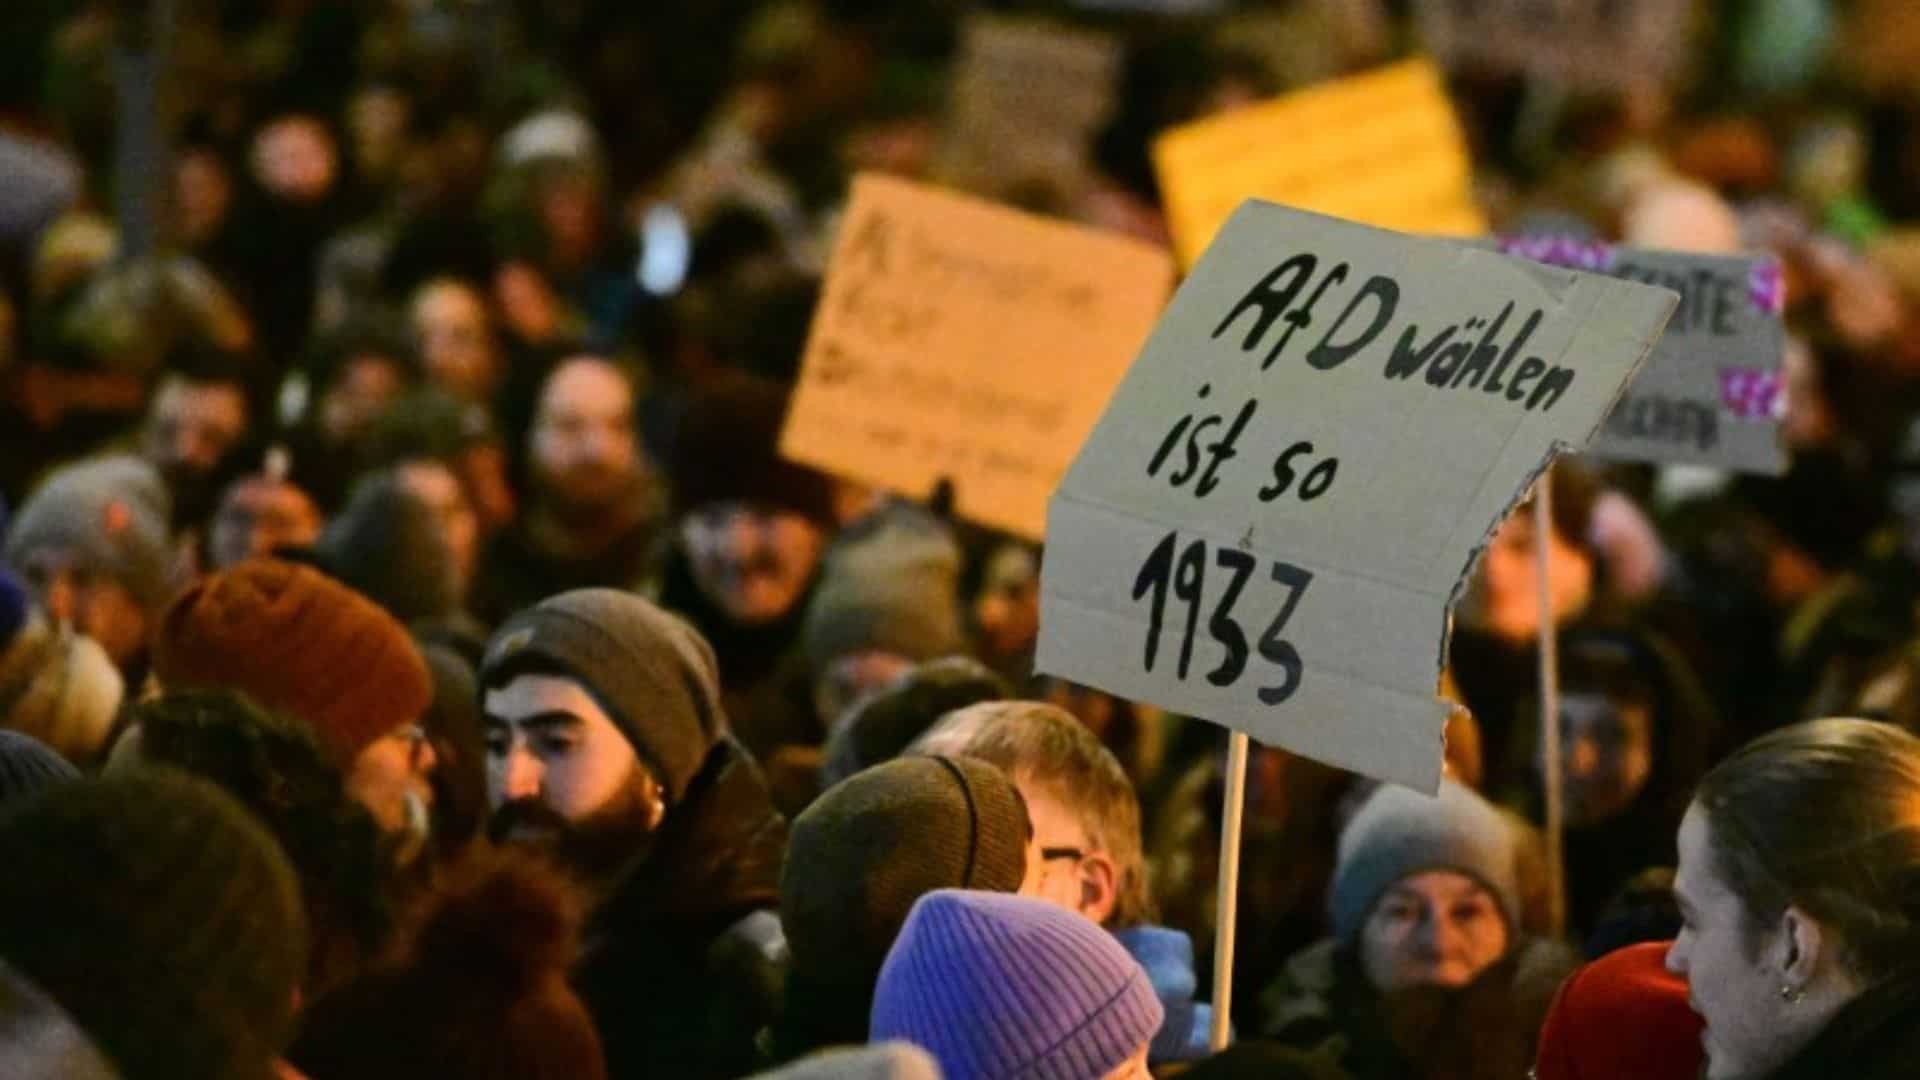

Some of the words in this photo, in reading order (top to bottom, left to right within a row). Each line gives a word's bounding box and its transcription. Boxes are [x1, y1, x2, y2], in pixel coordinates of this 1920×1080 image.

[1211, 253, 1400, 371] AfD
[1383, 300, 1576, 412] wählen
[1146, 383, 1258, 499] ist
[1257, 440, 1340, 503] so
[1131, 530, 1315, 707] 1933
